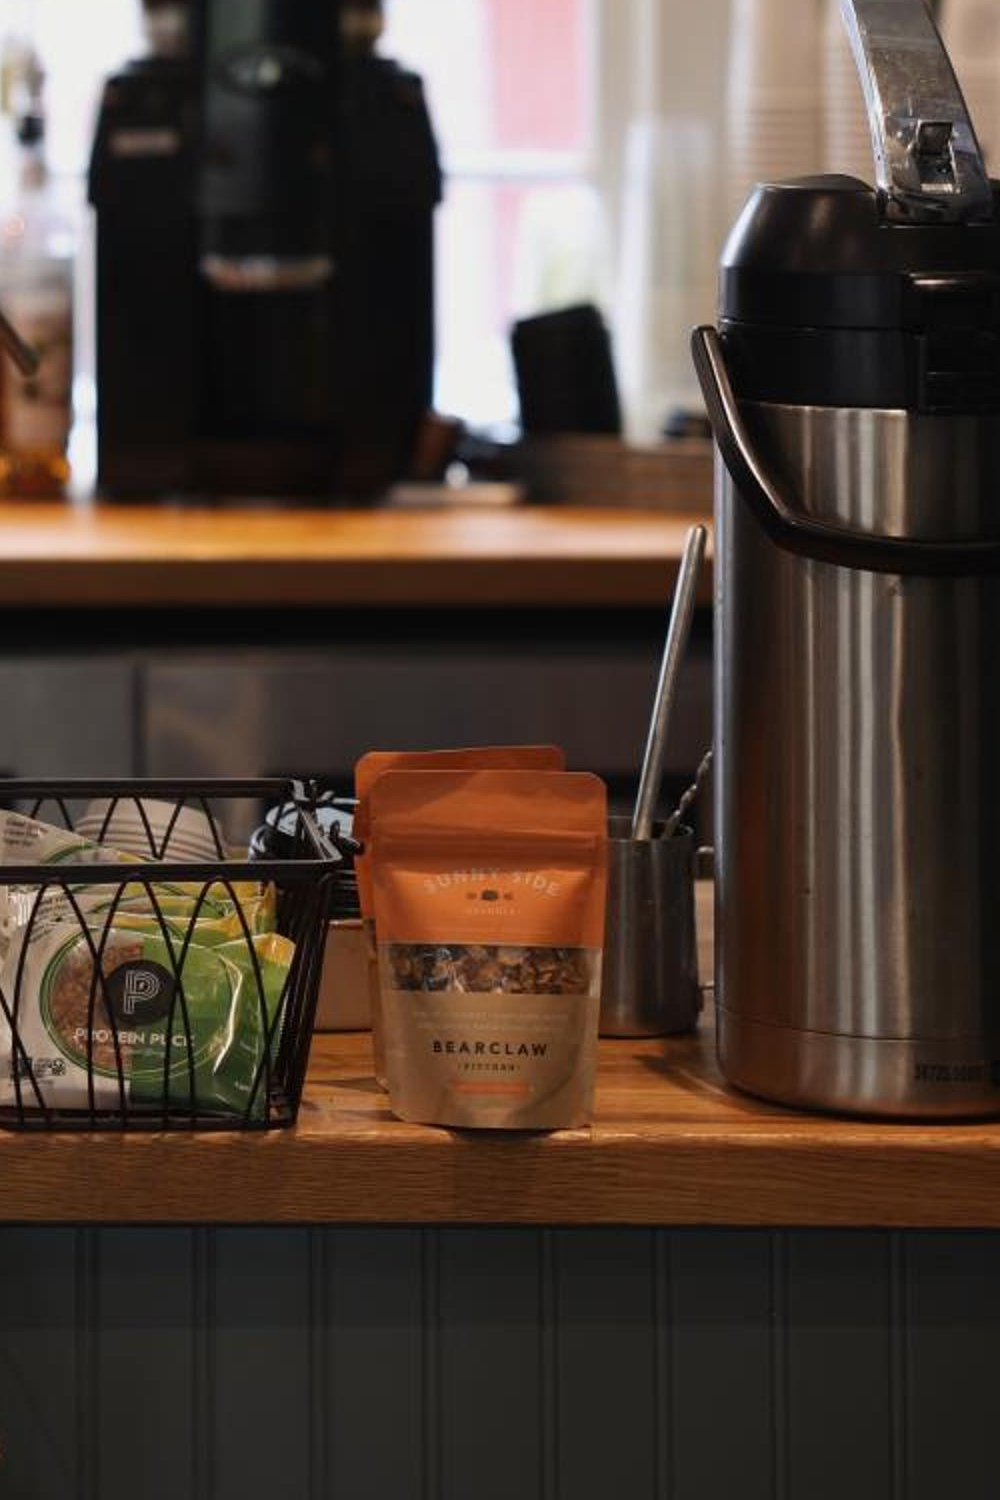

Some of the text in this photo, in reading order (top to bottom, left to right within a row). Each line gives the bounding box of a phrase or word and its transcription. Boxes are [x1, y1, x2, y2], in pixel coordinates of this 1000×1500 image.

[513, 870, 561, 897] SIDE
[73, 1027, 145, 1045] PROEIN
[432, 1040, 548, 1056] BEARCLAW
